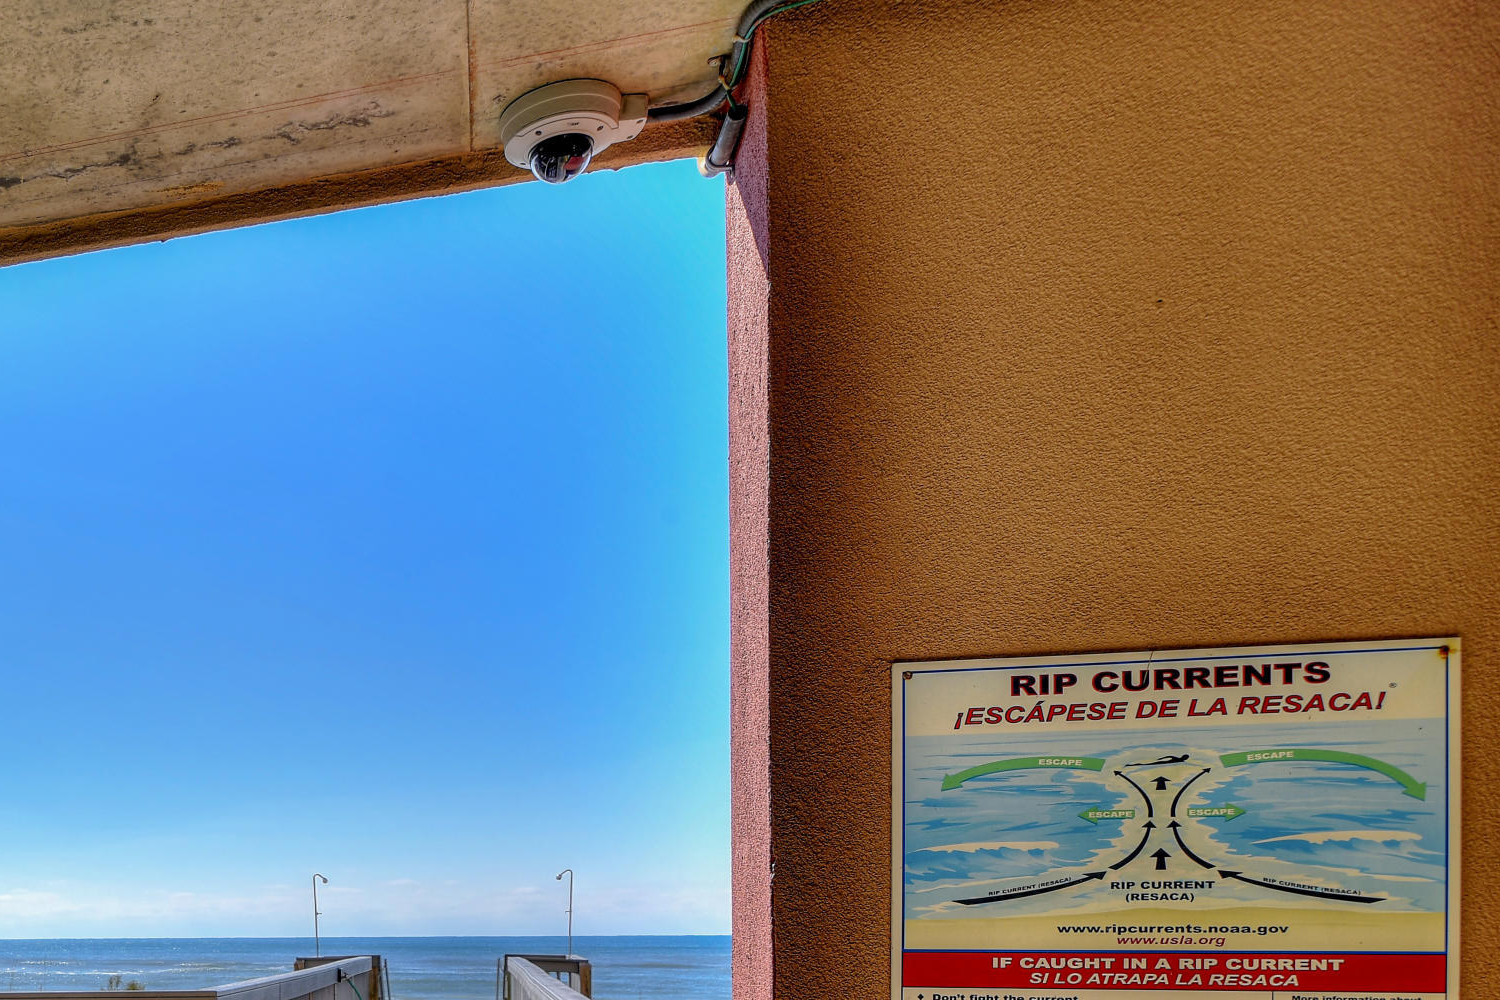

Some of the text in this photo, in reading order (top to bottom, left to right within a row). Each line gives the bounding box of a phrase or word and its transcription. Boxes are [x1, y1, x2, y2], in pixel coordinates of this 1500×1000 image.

[1010, 662, 1330, 696] RIP CURRENTS
[1135, 700, 1180, 718] DE
[1187, 698, 1227, 717] LA
[1237, 691, 1386, 715] RESACA!
[1247, 751, 1295, 761] ESCAPE
[1002, 884, 1036, 894] CURRENT
[1038, 877, 1072, 888] (RESACA)
[1145, 881, 1215, 890] CURRENT
[1279, 881, 1319, 891] CURRENT
[1125, 893, 1194, 902] (RESACA)
[1057, 924, 1289, 935] www.ripcurrents.noaa.gov
[1117, 936, 1226, 947] www.usla.org
[992, 958, 1345, 971] IF CAUGHT IN A RIP CURRENT
[1029, 972, 1299, 987] SI LO ATRAPA LA RESACA
